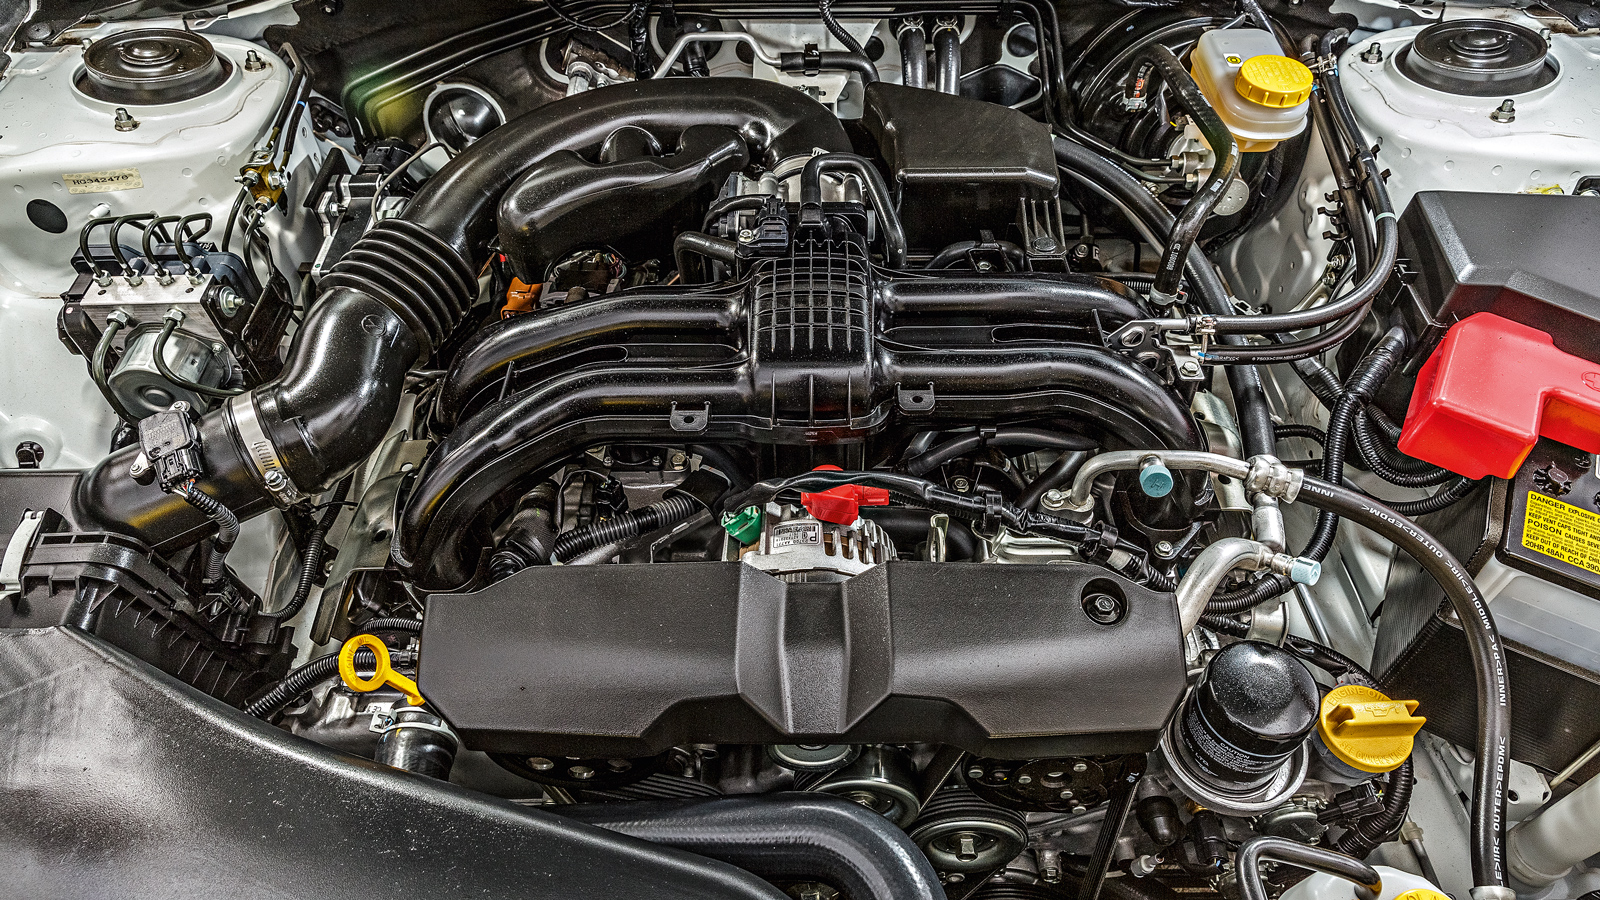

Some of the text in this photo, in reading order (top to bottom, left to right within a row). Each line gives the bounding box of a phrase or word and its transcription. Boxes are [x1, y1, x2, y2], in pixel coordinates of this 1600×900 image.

[1530, 494, 1565, 510] DANGER
[1568, 508, 1595, 521] EXPLOSIVE
[1527, 518, 1562, 536] POISON
[1564, 532, 1586, 544] CAUSES
[1528, 511, 1542, 520] KEEP
[1543, 516, 1556, 525] VENT
[1557, 522, 1572, 532] CAPS
[1526, 533, 1540, 542] KEEP
[1540, 538, 1551, 546] OUT
[1560, 545, 1579, 557] REACH
[1525, 540, 1600, 573] 20HR 48Ah CCA 390
[1327, 686, 1364, 707] ENGINE
[1219, 742, 1250, 760] CAUTION
[1339, 741, 1355, 756] SEE
